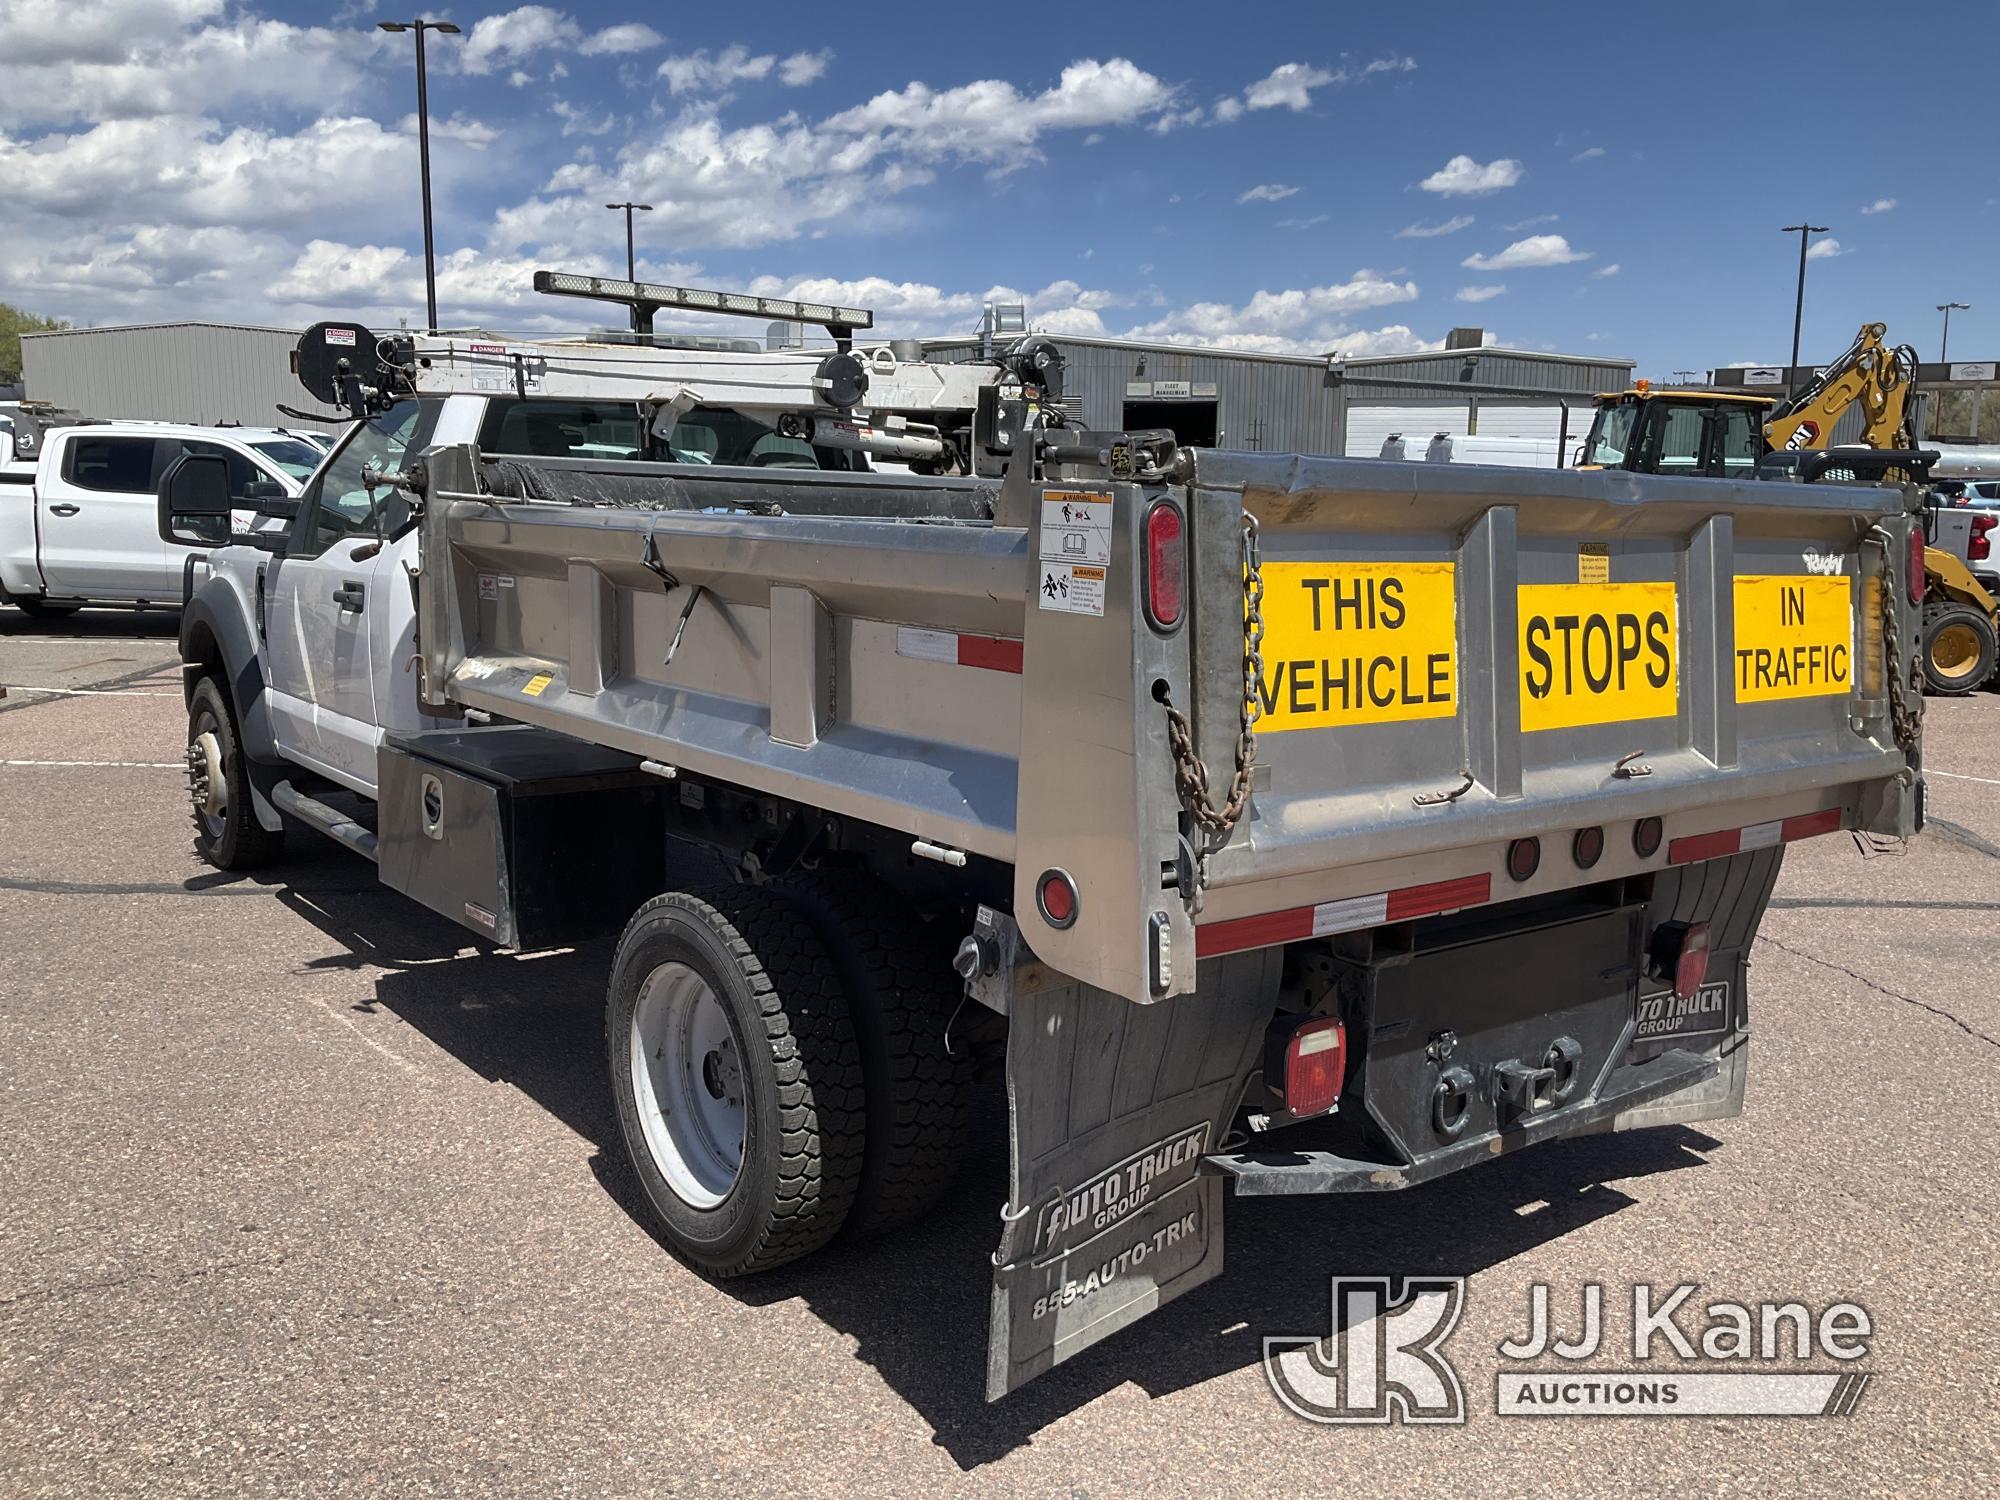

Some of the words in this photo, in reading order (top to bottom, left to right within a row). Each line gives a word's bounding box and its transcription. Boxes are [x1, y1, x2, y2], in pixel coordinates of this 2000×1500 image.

[1785, 424, 1813, 450] CAT
[1078, 569, 1104, 577] WARNING
[1301, 577, 1406, 631] THIS
[1780, 586, 1805, 626] IN
[1525, 610, 1670, 699] STOPS
[1737, 643, 1847, 689] TRAFFIC
[1251, 653, 1451, 716] VEHICLE
[1638, 1016, 1683, 1034] GROUP
[1667, 989, 1722, 1017] TRUCK
[1046, 1173, 1121, 1248] AUTO
[1126, 1131, 1202, 1193] TRUCK
[1094, 1183, 1150, 1230] GROUP
[1032, 1212, 1196, 1320] 855-AUTO-TRK
